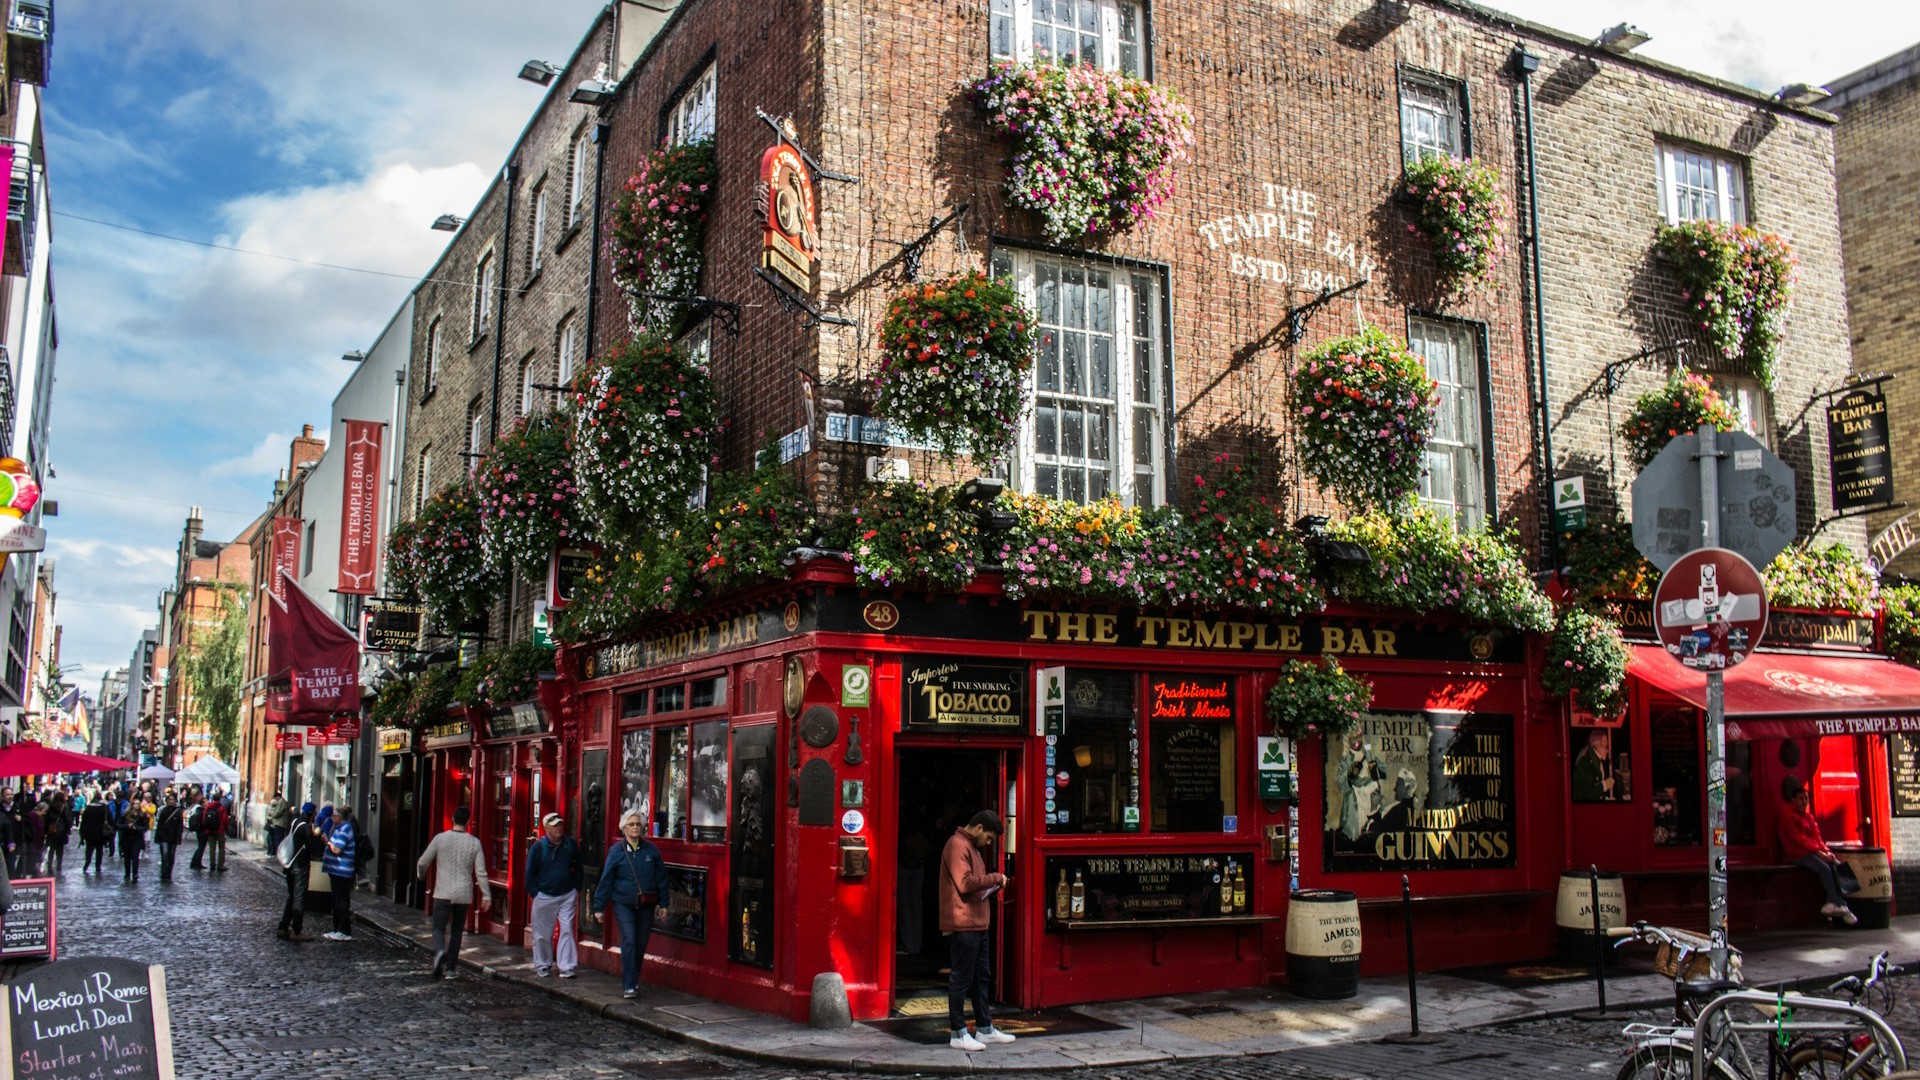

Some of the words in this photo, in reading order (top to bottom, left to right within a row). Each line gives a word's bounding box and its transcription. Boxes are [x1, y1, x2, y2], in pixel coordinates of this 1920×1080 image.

[1263, 181, 1317, 217] THE
[1199, 213, 1314, 250] TEMPLE
[1325, 228, 1376, 284] BAR
[1230, 253, 1293, 284] ESTD.
[1846, 395, 1865, 406] THE
[1829, 401, 1885, 424] TEMPLE
[1843, 418, 1873, 435] BAR
[1834, 452, 1853, 463] BEER
[1854, 445, 1886, 458] GARDEN
[351, 451, 365, 478] BAR
[364, 471, 374, 493] CO.
[1837, 480, 1857, 492] LIVE
[1858, 476, 1886, 489] MUSIC
[1848, 488, 1875, 499] DAILY
[349, 480, 362, 542] TEMPLE
[362, 496, 373, 547] TRADING
[1873, 519, 1916, 565] THE
[347, 543, 360, 566] THE
[386, 604, 415, 613] TEMPLE
[787, 608, 798, 626] 48
[872, 605, 893, 625] 48
[384, 637, 411, 645] STORE
[645, 626, 710, 667] TEMPLE
[718, 614, 760, 649] BAR
[1022, 610, 1119, 645] THE
[1136, 616, 1303, 652] TEMPLE
[1321, 626, 1398, 656] BAR
[296, 673, 354, 688] TEMPLE
[312, 667, 337, 677] THE
[907, 663, 959, 685] Importers
[311, 687, 341, 699] BAR
[952, 681, 973, 690] FINE
[973, 682, 1011, 692] SMOKING
[1154, 681, 1227, 700] Traditional
[921, 685, 1011, 719] TOBACCO
[1152, 700, 1187, 718] Irish
[1192, 701, 1230, 719] Music
[939, 713, 974, 723] Always
[979, 715, 988, 723] in
[991, 715, 1018, 724] Stock
[1362, 720, 1428, 736] TEMPLE
[1815, 719, 1845, 734] THE
[1845, 717, 1899, 733] TEMPLE
[1168, 729, 1201, 745] TEMPLE
[1381, 737, 1413, 754] BAR
[1475, 734, 1501, 754] THE
[1442, 755, 1501, 776] EMPEROR
[1486, 778, 1501, 798] OF
[1407, 806, 1457, 830] MALTED
[1457, 799, 1506, 827] LIQUORS
[1375, 830, 1509, 861] GUINNESS
[1088, 859, 1121, 874] THE
[1124, 858, 1185, 874] TEMPLE
[1139, 875, 1170, 884] DUBLIN
[7, 902, 45, 911] OFFEE
[1124, 899, 1141, 909] LIVE
[1142, 899, 1161, 907] MUSIC
[1163, 898, 1184, 906] DAILY
[1579, 904, 1621, 917] JAESON
[5, 932, 45, 940] DONUTS
[15, 983, 84, 1015] Mexico
[92, 972, 148, 1004] Rome
[34, 1010, 90, 1040] Lunch
[91, 1003, 133, 1030] Deal
[20, 1044, 82, 1074] Starter
[90, 1051, 96, 1059] +
[101, 1034, 148, 1061] Main
[89, 1067, 103, 1079] of
[113, 1064, 143, 1076] wine
